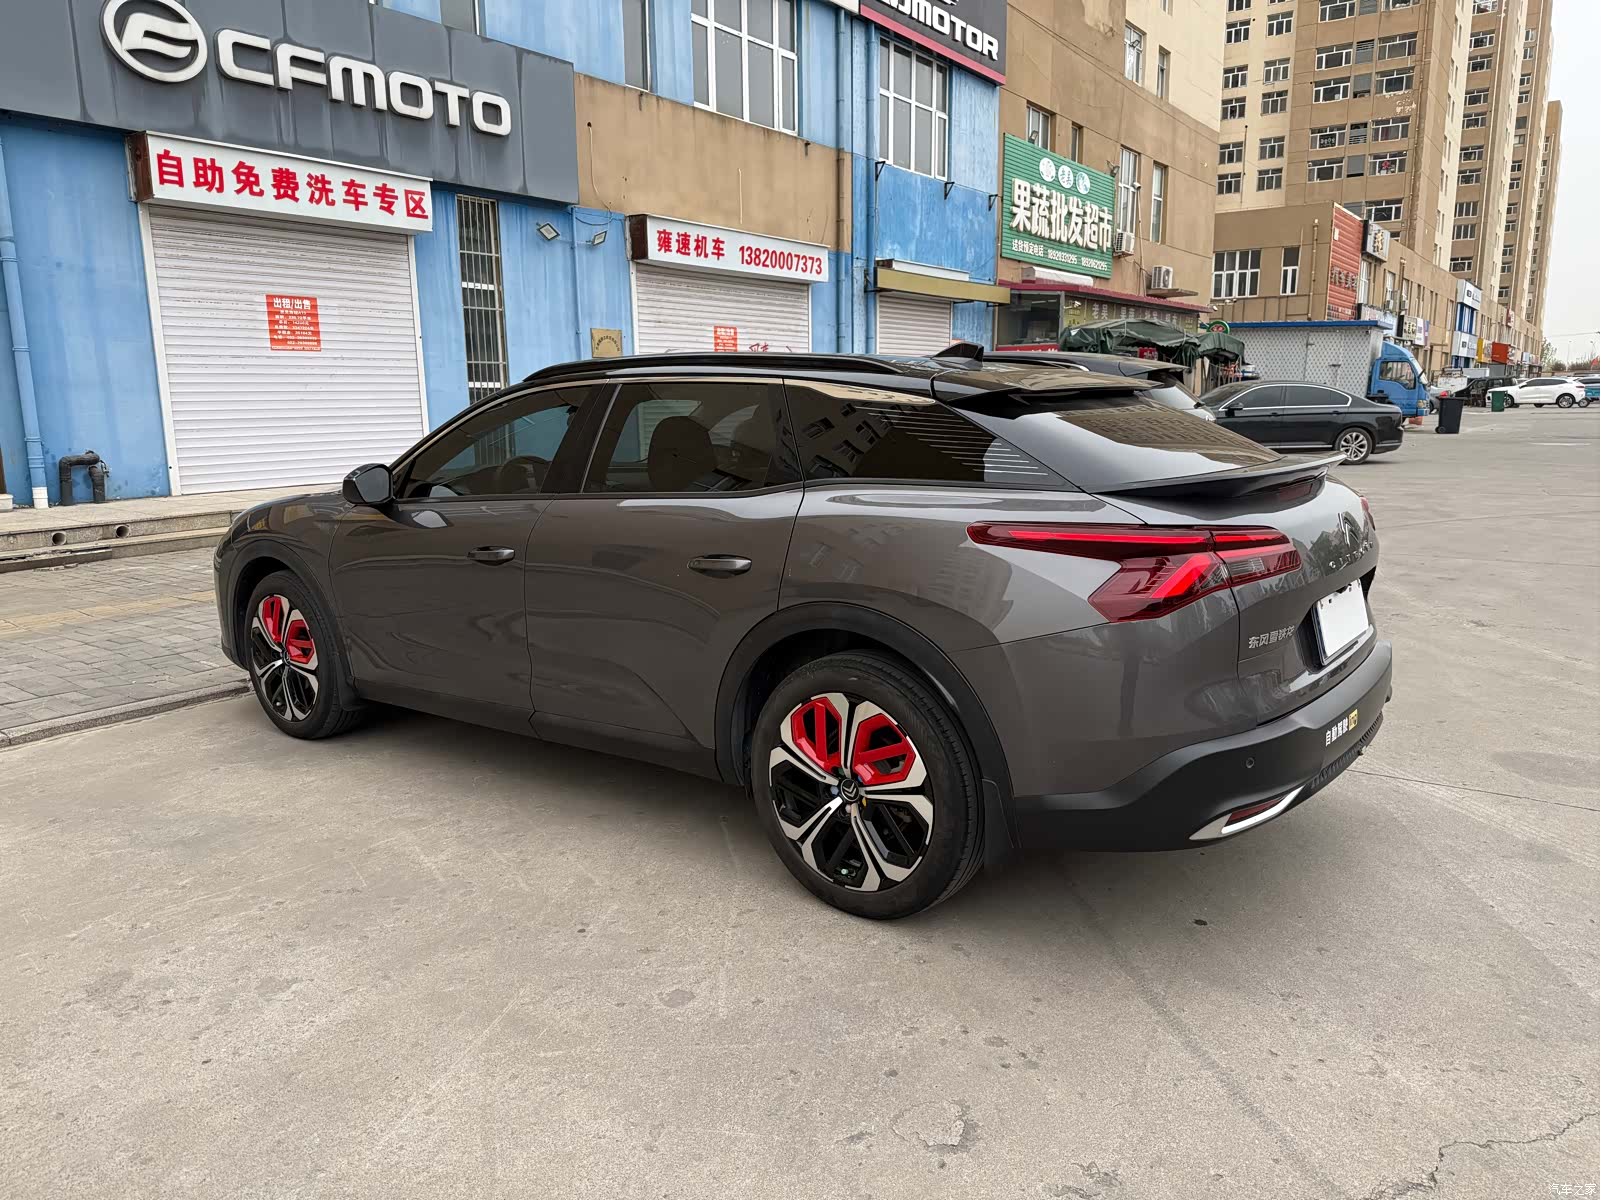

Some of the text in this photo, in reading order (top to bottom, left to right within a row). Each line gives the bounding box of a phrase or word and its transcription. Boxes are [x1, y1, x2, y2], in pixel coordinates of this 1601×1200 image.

[216, 28, 512, 137] CFMOTO
[156, 149, 429, 220] 自助免费洗车专区
[1010, 178, 1113, 253] 果蔬批发超市
[656, 229, 823, 275] 雍速机车 13820007373
[274, 298, 311, 310] 出租/出售
[1249, 625, 1295, 649] 东风雪铁龙
